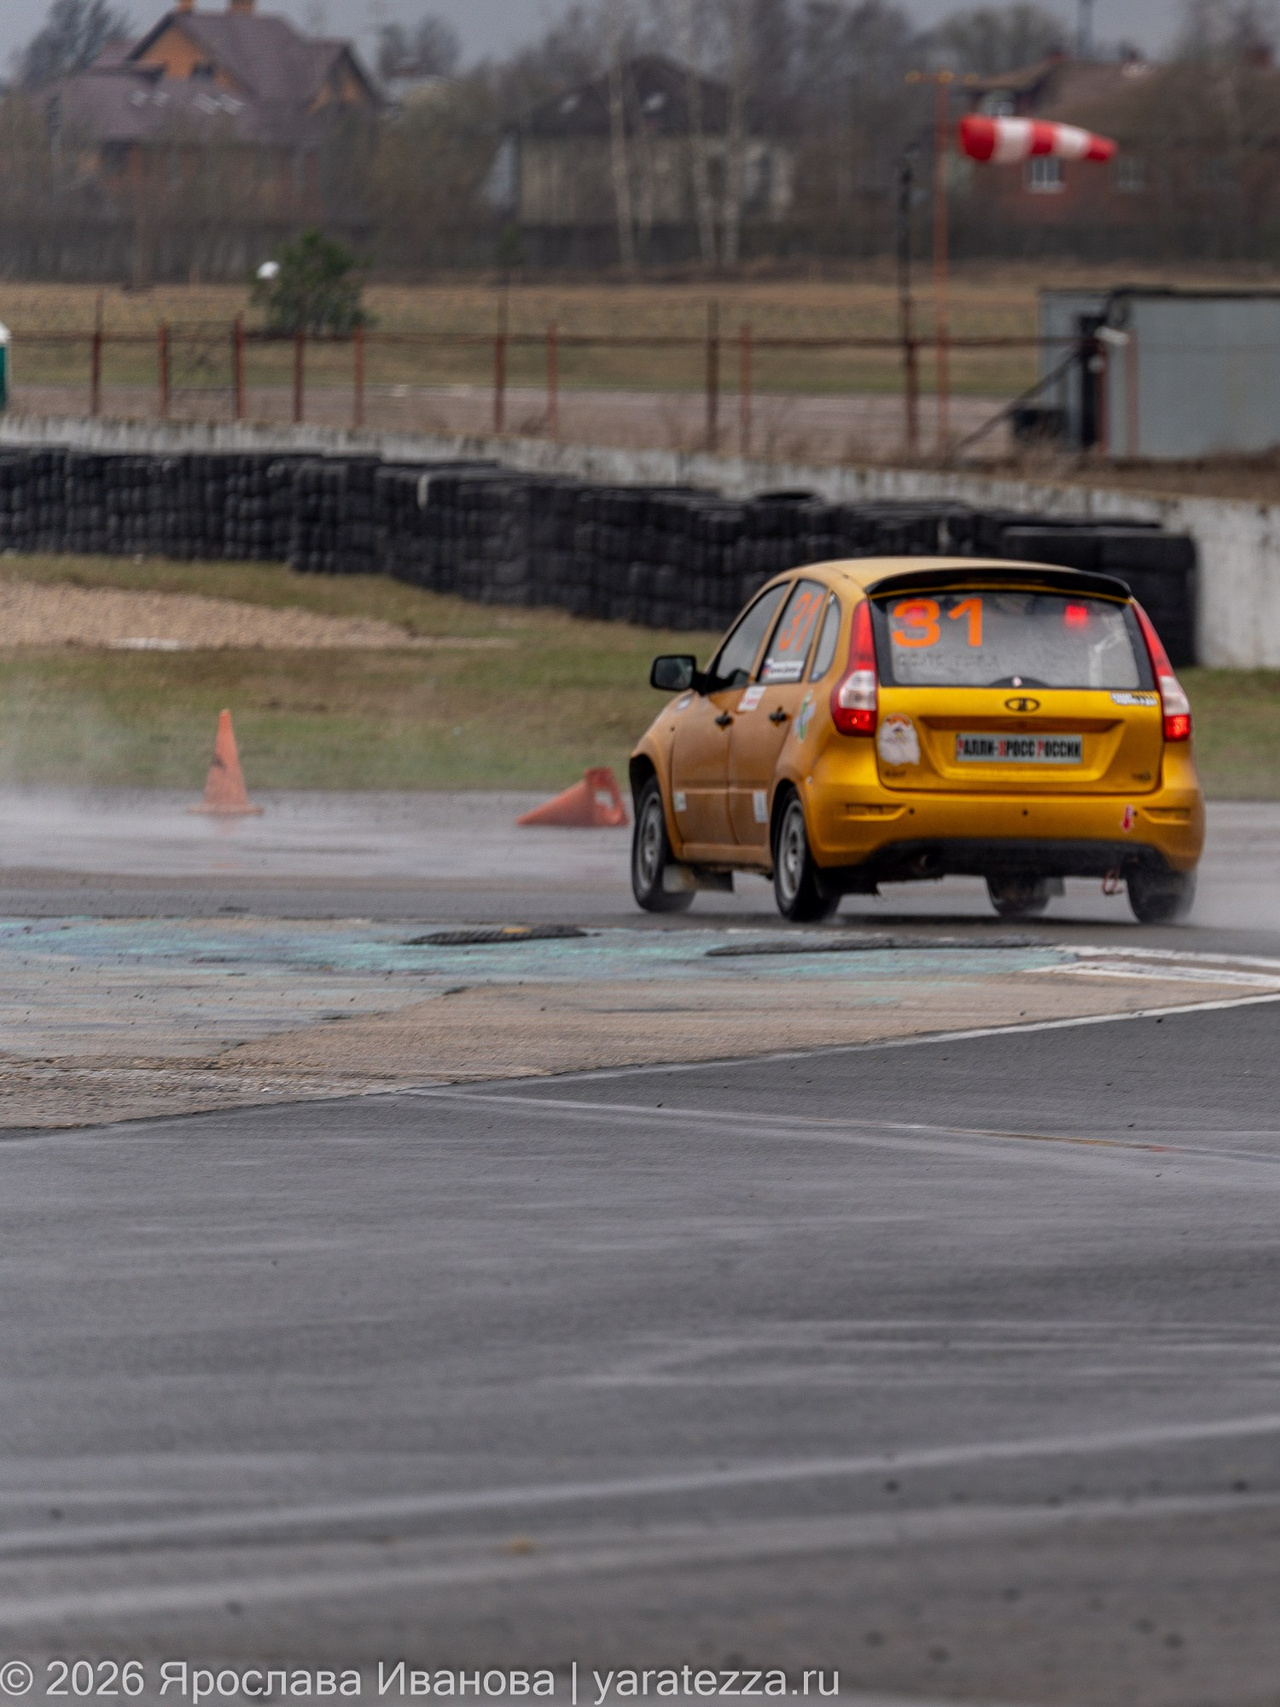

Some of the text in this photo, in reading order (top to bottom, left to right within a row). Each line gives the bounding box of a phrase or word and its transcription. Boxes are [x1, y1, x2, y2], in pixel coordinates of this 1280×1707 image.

[778, 590, 824, 653] 31
[892, 597, 983, 648] 31
[1036, 738, 1081, 758] РОССИИ
